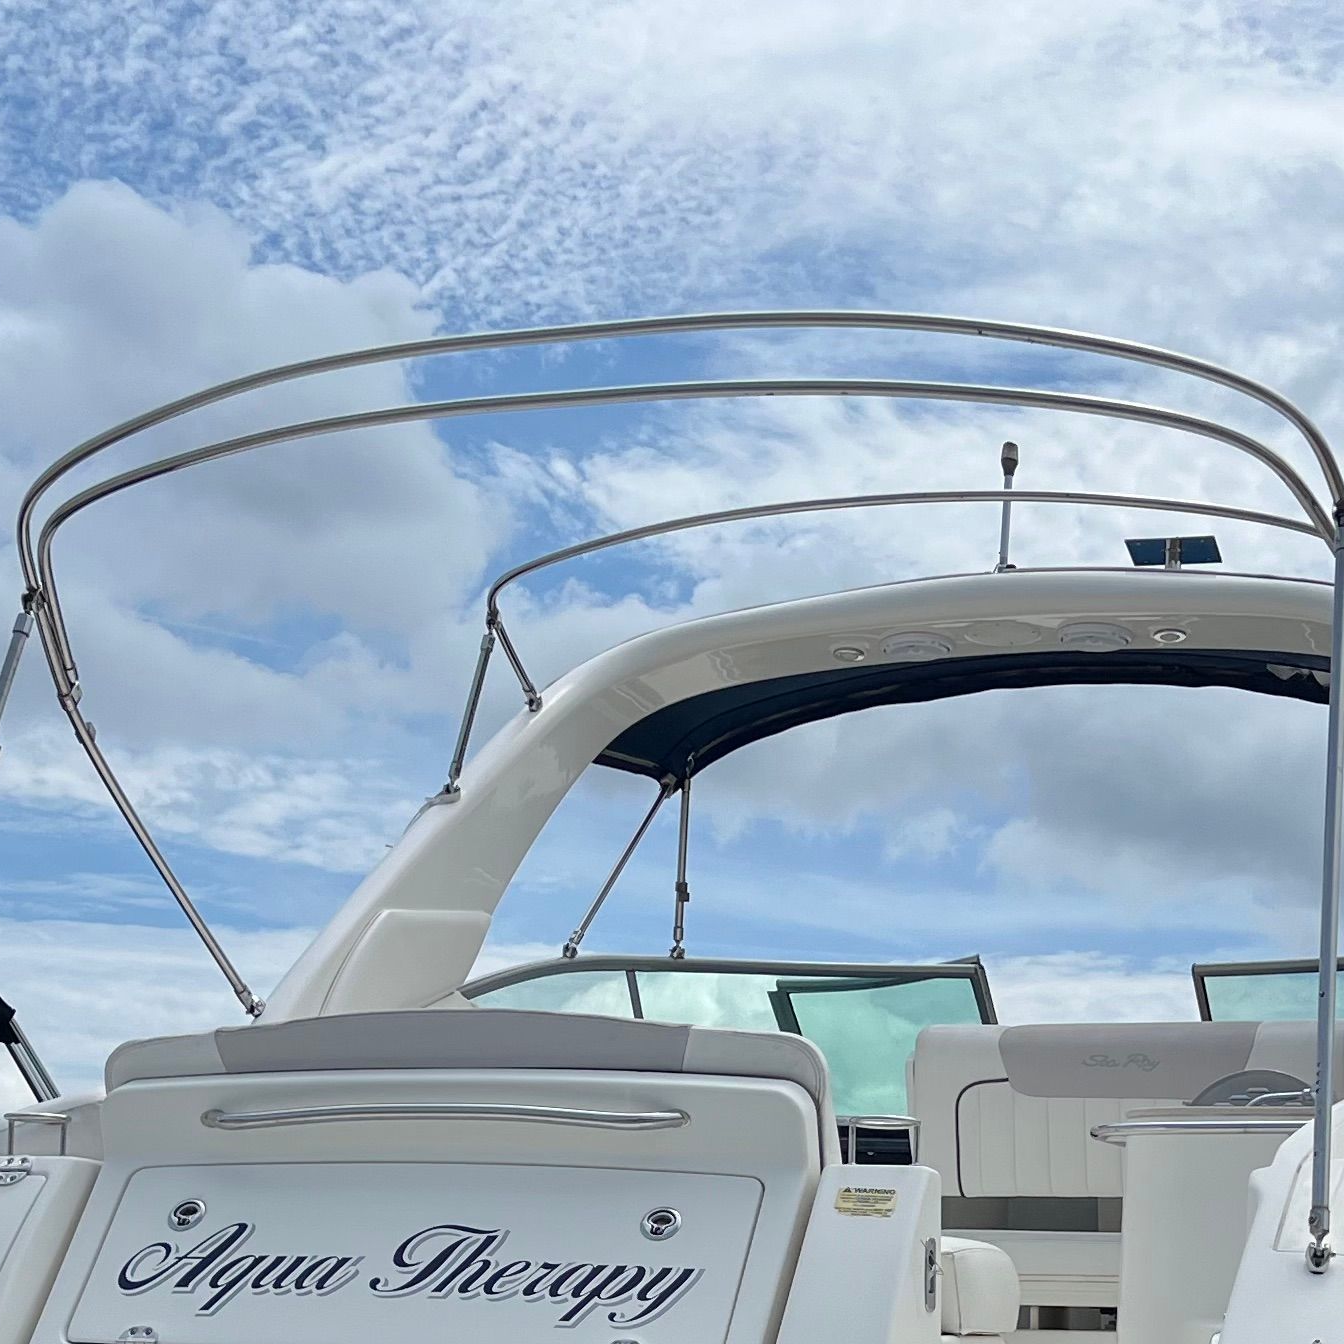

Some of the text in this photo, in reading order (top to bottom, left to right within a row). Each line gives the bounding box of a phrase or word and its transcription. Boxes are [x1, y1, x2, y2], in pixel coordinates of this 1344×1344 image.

[1081, 1053, 1160, 1072] Sea Ray
[117, 1222, 706, 1329] Aqua Therapy
